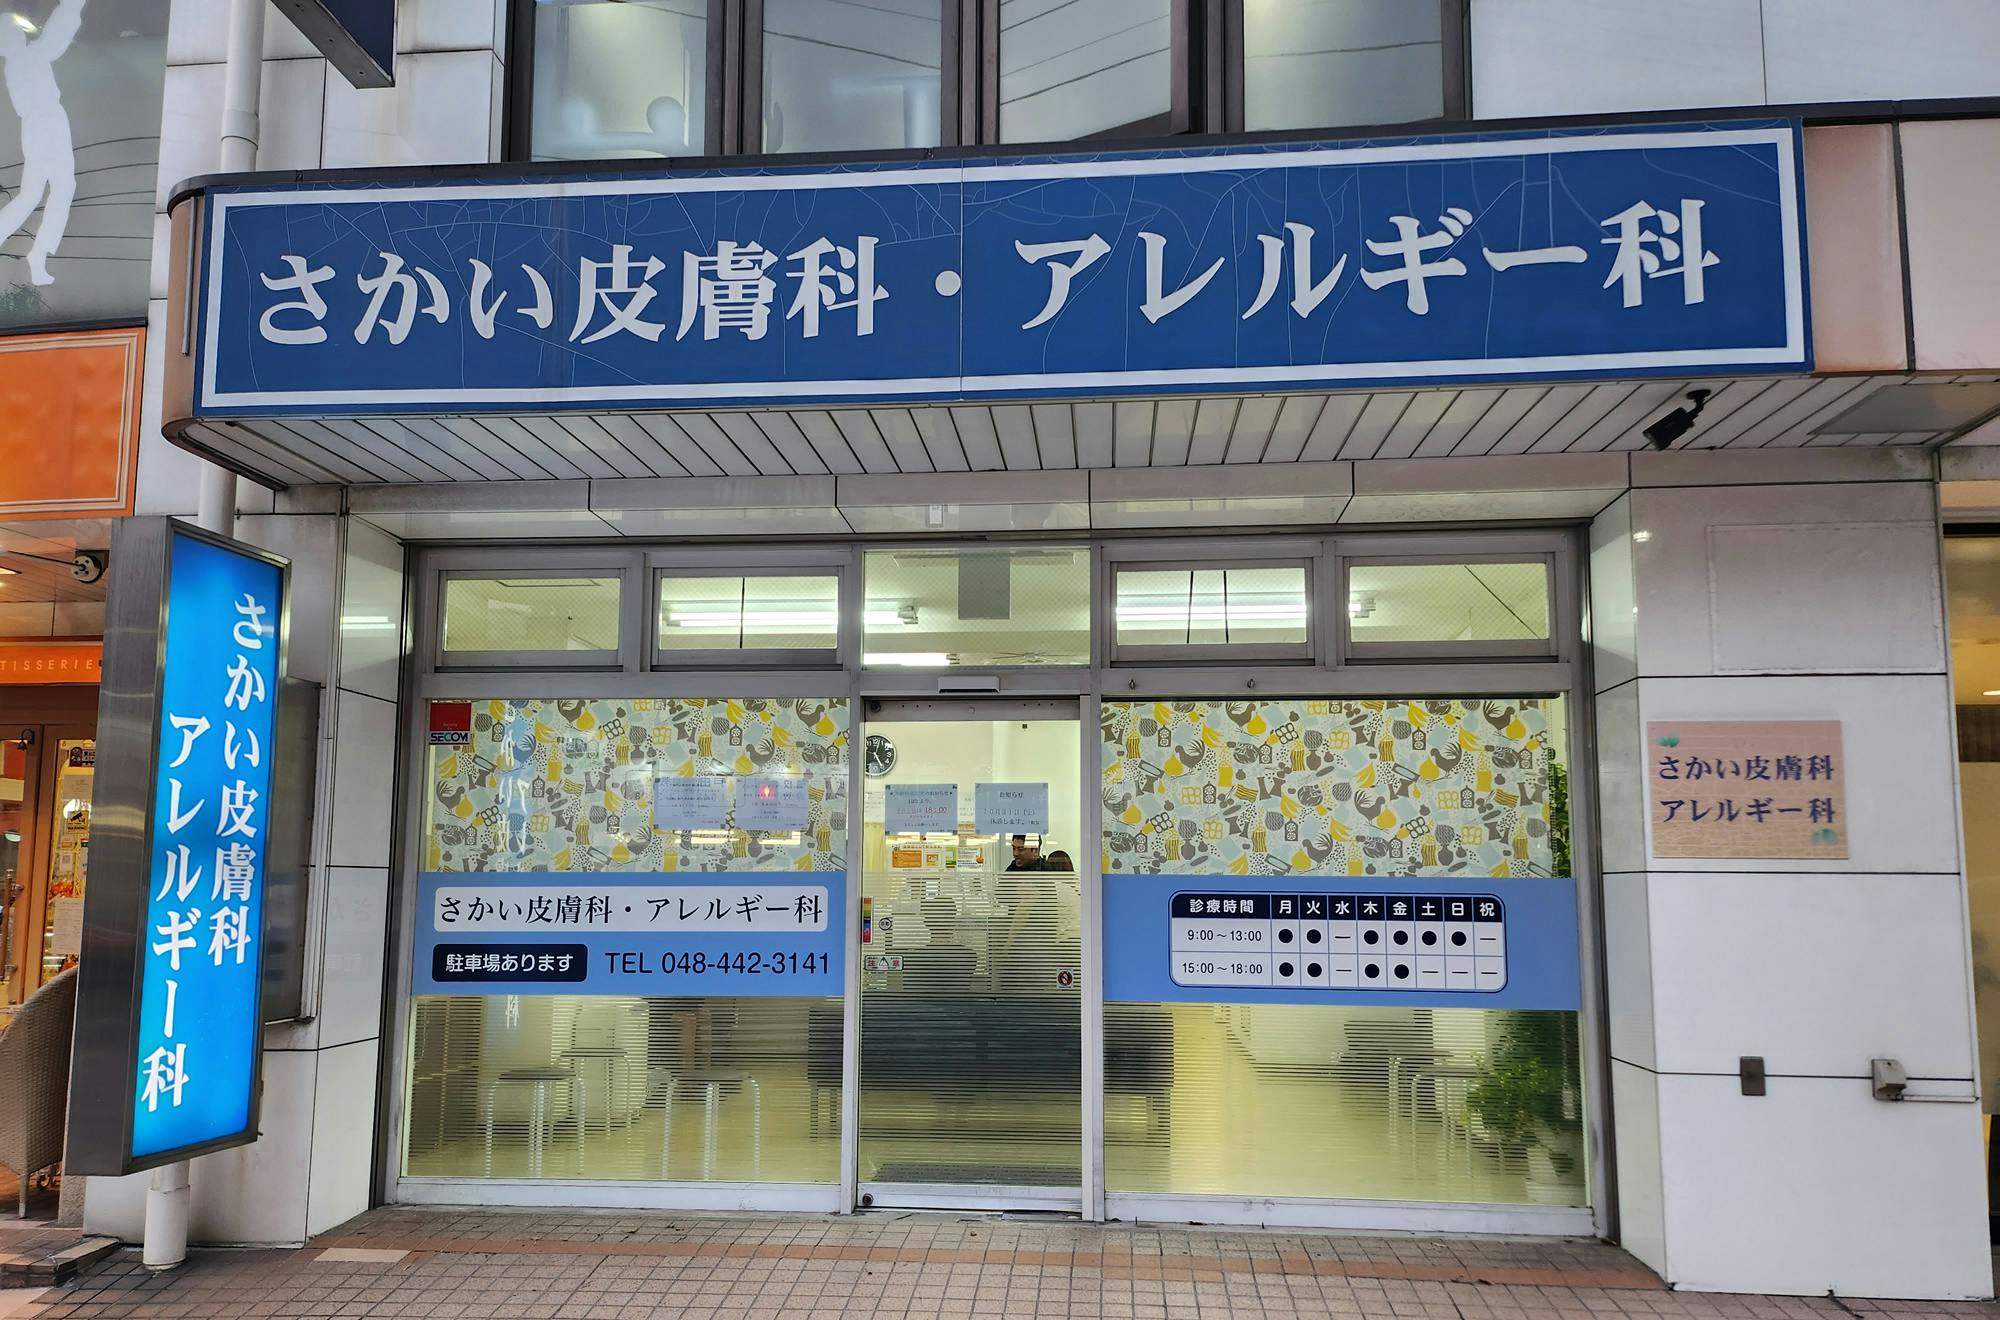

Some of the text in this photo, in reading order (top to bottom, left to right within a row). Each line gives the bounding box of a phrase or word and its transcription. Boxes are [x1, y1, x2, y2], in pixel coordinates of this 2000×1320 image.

[258, 198, 1721, 346] さかい皮膚科・アレルギー科
[430, 732, 468, 742] SECOM
[207, 593, 267, 966] さかい皮膚科
[1658, 755, 1835, 781] さかい皮膚科
[999, 791, 1024, 799] お知らせ
[1660, 797, 1836, 824] アレルギー科
[140, 712, 211, 1113] アレルギー科
[440, 895, 823, 924] さかい皮膚科・アレルギー科
[1189, 899, 1495, 917] 診療時間 月 火 水 木 金 土 日 祝
[446, 953, 574, 972] 駐車場あります
[605, 951, 828, 974] TEL 048-442-3141
